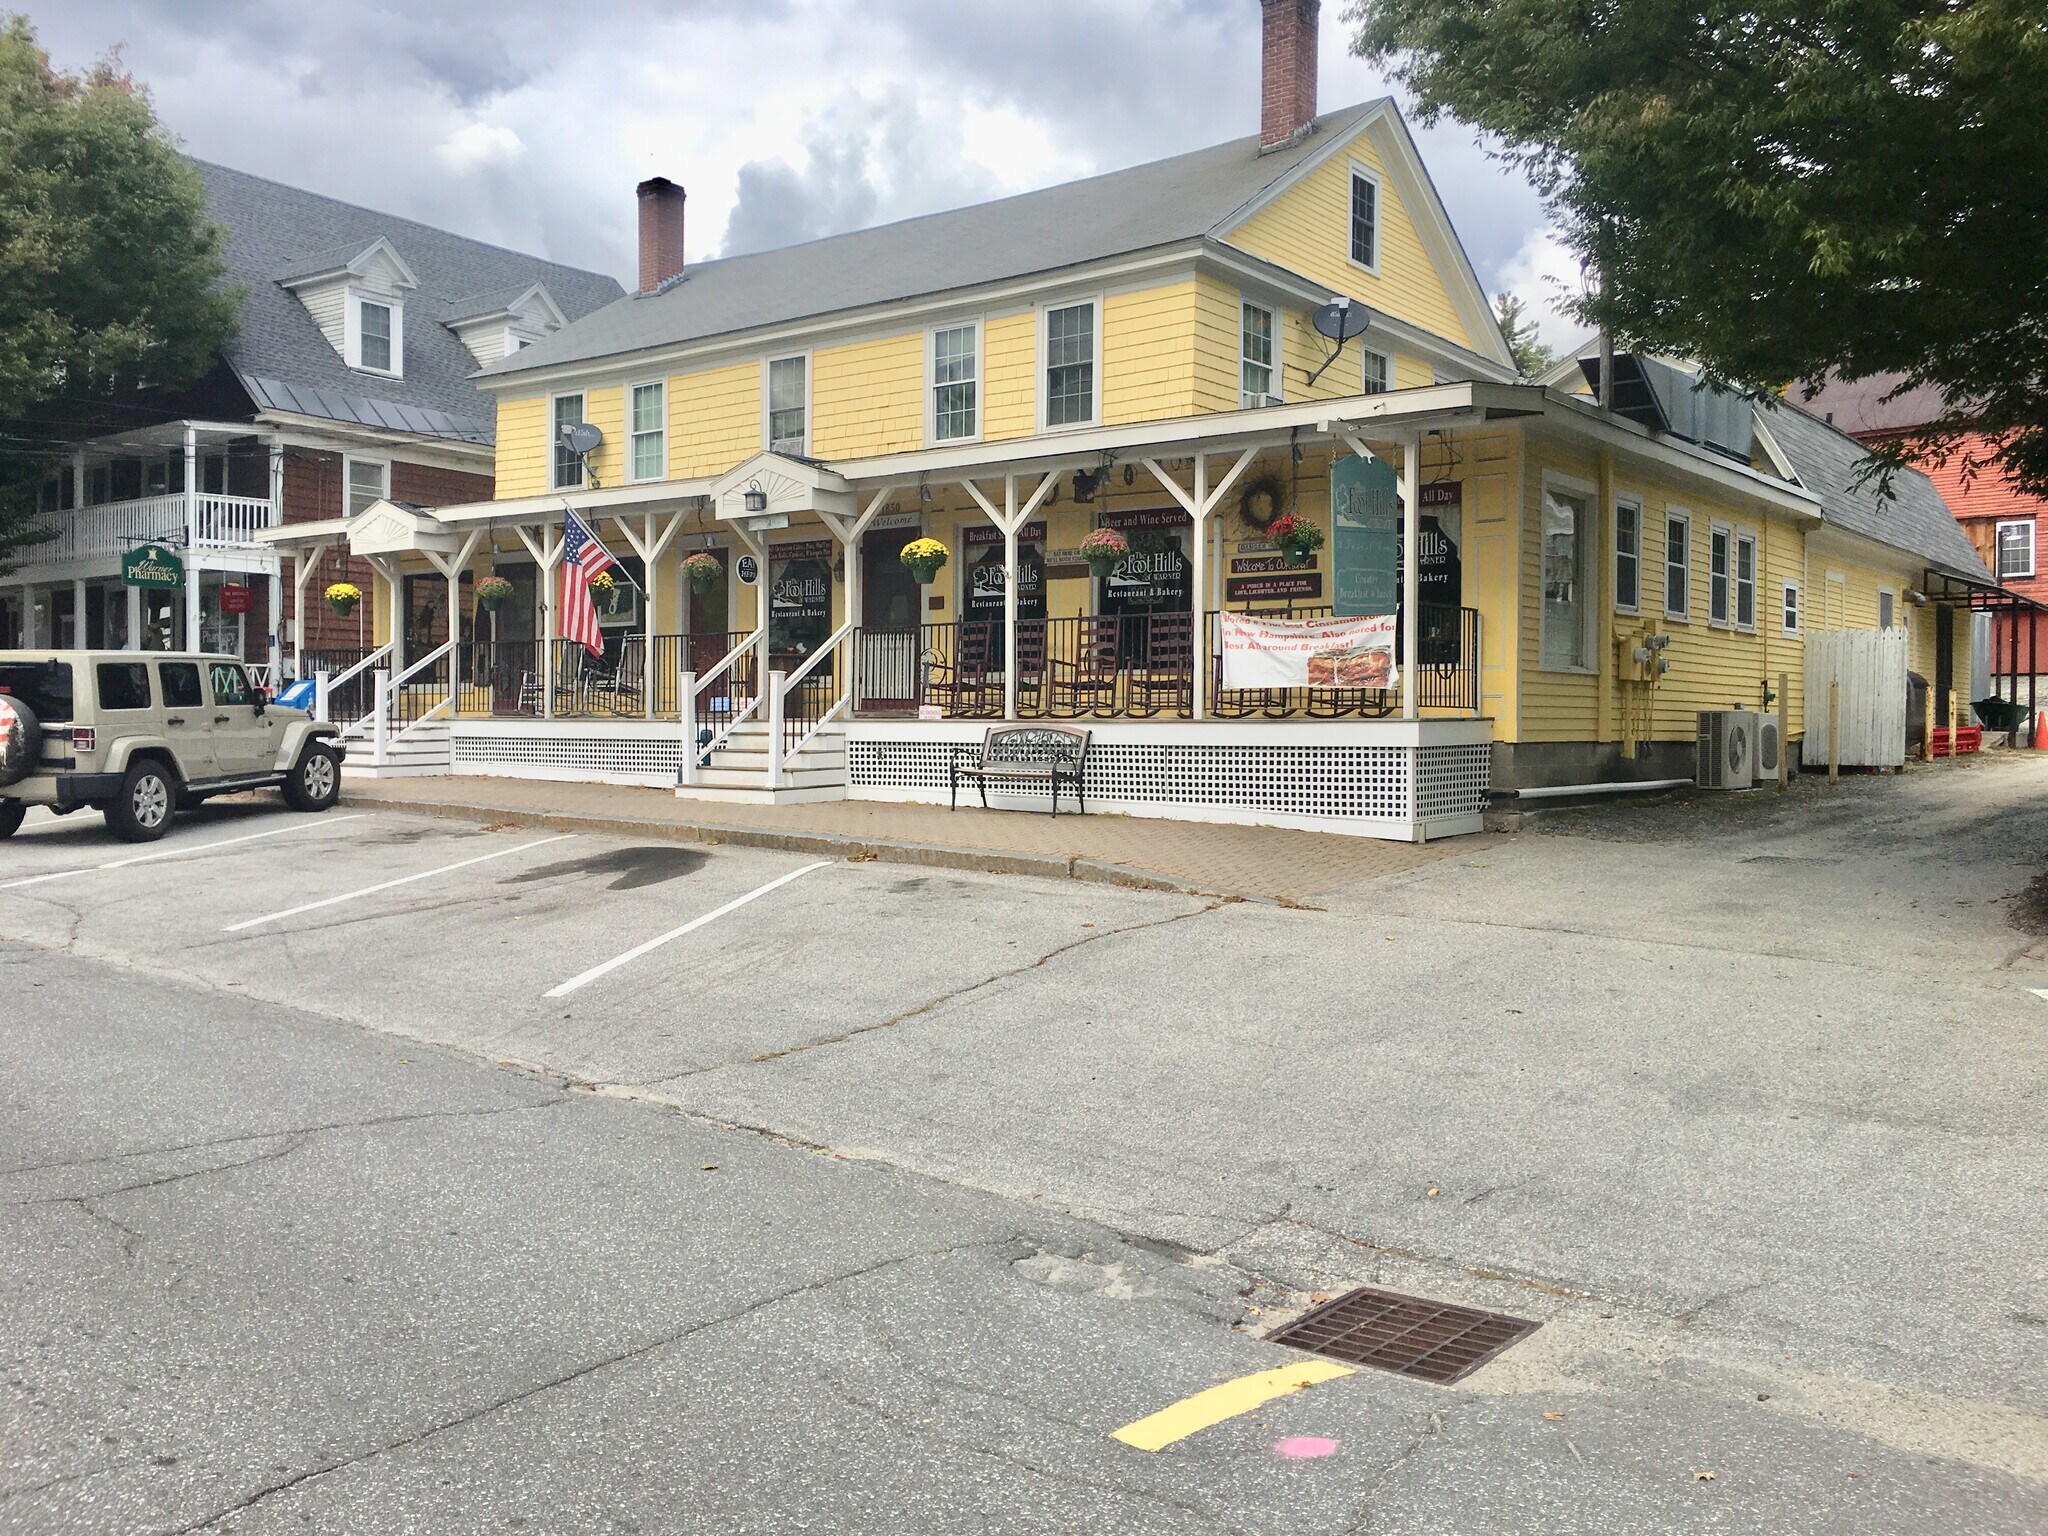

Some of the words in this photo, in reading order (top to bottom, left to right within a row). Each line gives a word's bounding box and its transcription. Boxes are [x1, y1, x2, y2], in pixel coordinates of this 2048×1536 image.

[1422, 489, 1435, 502] All
[1437, 488, 1454, 505] Day
[872, 516, 911, 527] Welcome
[1105, 516, 1122, 528] Beer
[1123, 515, 1138, 527] and
[1140, 513, 1159, 525] Wine
[1161, 511, 1187, 524] Served
[969, 530, 997, 541] Breakfast
[1030, 526, 1042, 540] Day
[1127, 553, 1153, 573] Foot
[1154, 551, 1183, 572] Hills
[128, 566, 178, 585] Pharmacy
[988, 566, 1005, 584] Foo
[1153, 572, 1181, 581] WARNER
[785, 579, 804, 597] Foot
[805, 577, 827, 596] Hills
[1108, 589, 1147, 598] Restaurant
[1149, 588, 1156, 597] &
[1157, 587, 1183, 598] Bakery
[971, 599, 1003, 608] Restauran
[771, 610, 800, 618] Restaurant
[807, 608, 826, 617] Bakery
[1321, 630, 1346, 639] Also
[1349, 623, 1377, 636] noted
